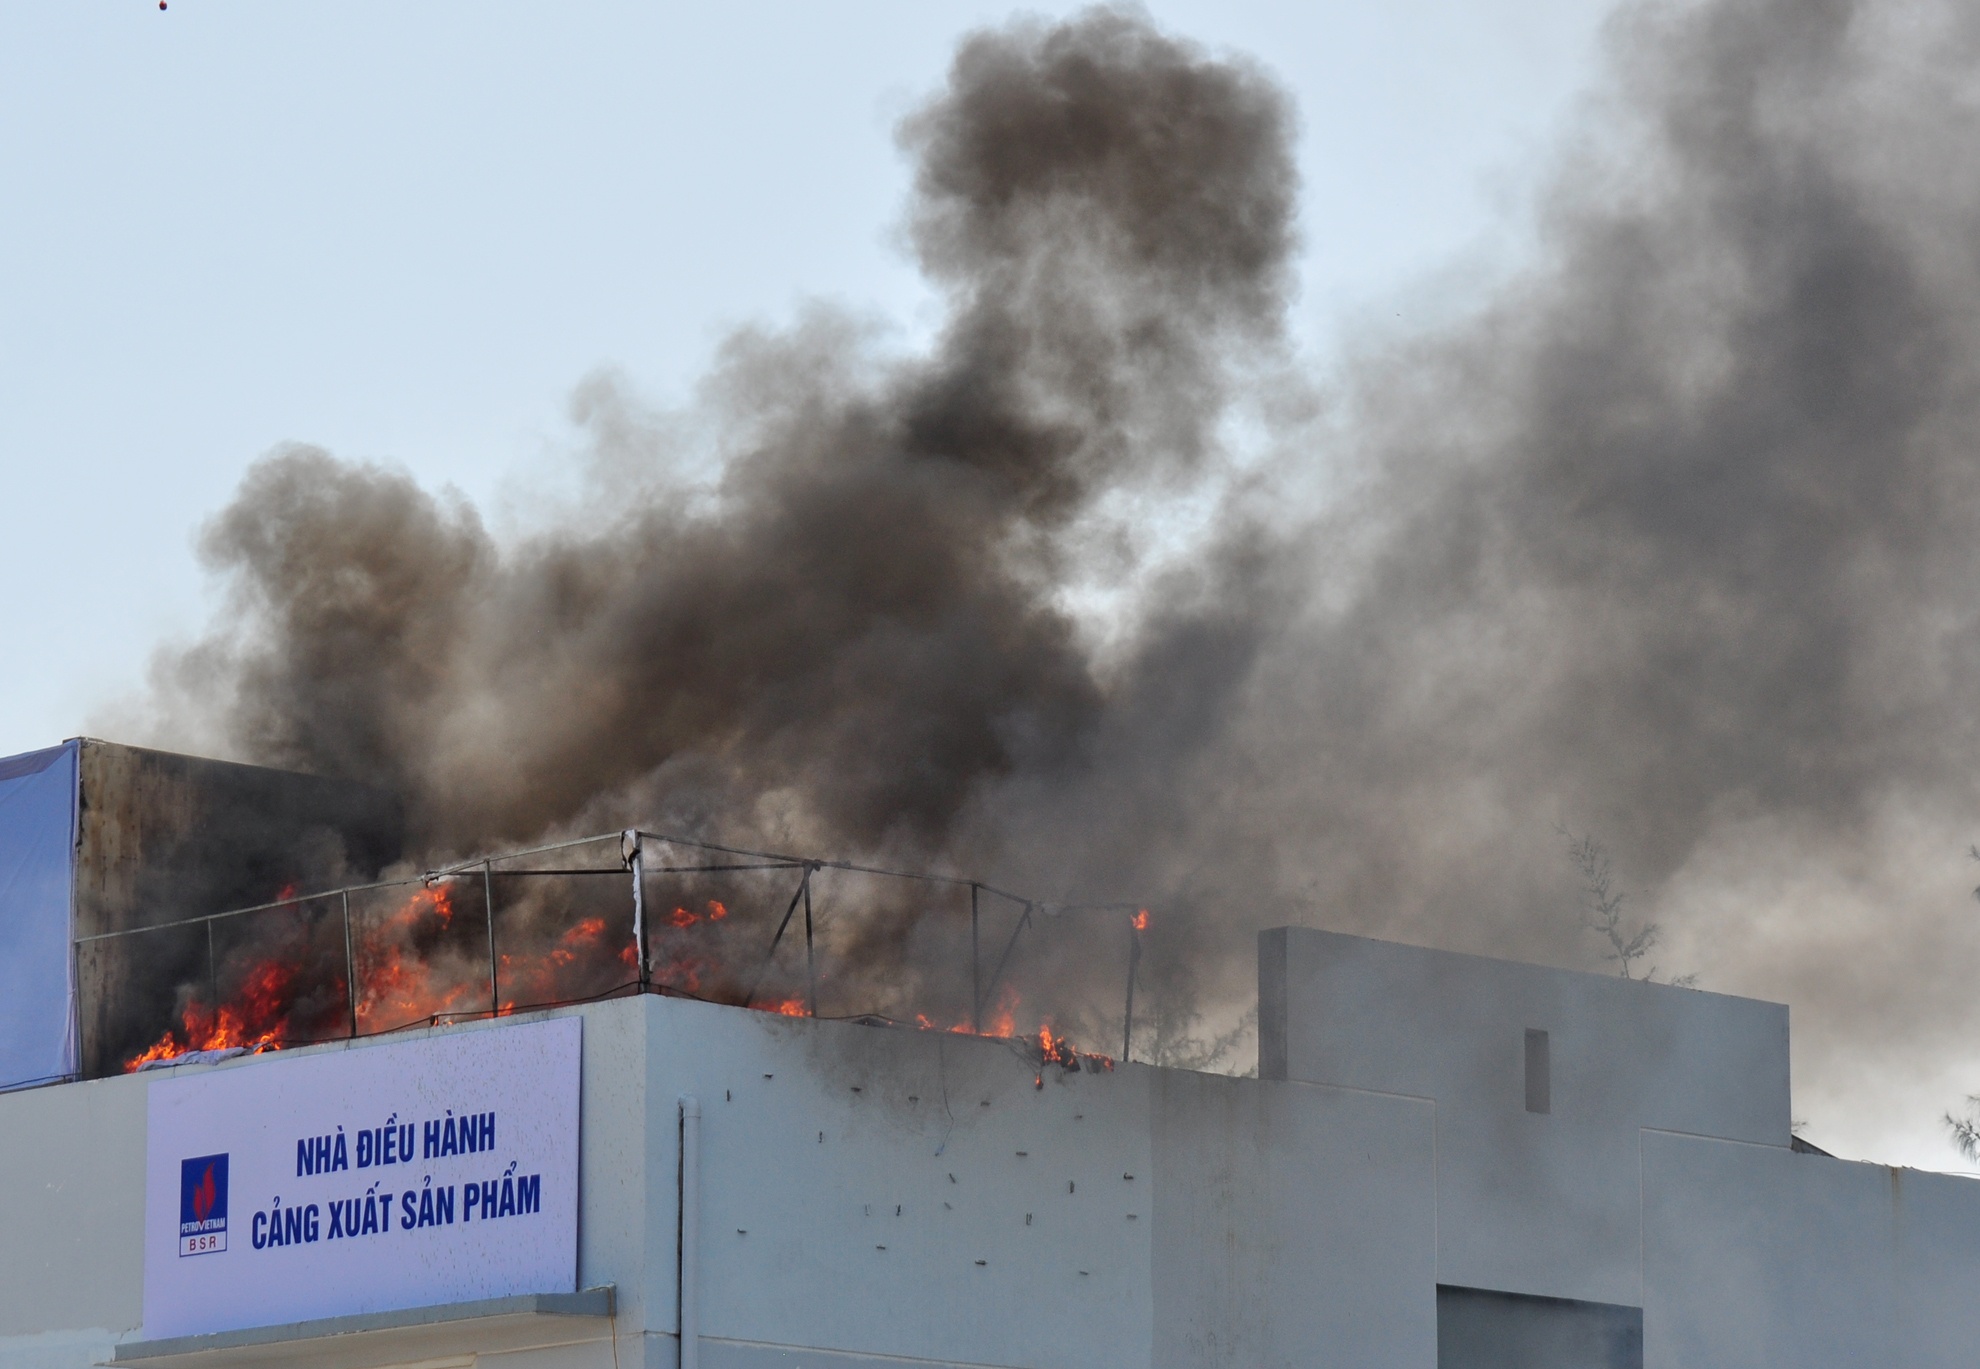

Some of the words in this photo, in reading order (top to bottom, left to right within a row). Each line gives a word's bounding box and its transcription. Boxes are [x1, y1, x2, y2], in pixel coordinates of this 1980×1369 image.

[297, 1125, 348, 1177] NHÀ
[356, 1113, 414, 1168] ĐIỀU
[424, 1109, 495, 1159] HÀNH
[181, 1217, 226, 1234] PETROVIETNAM
[252, 1196, 319, 1250] CẢNG
[327, 1181, 393, 1240] XUẤT
[401, 1175, 454, 1230] SẢN
[463, 1160, 540, 1222] PHẨM
